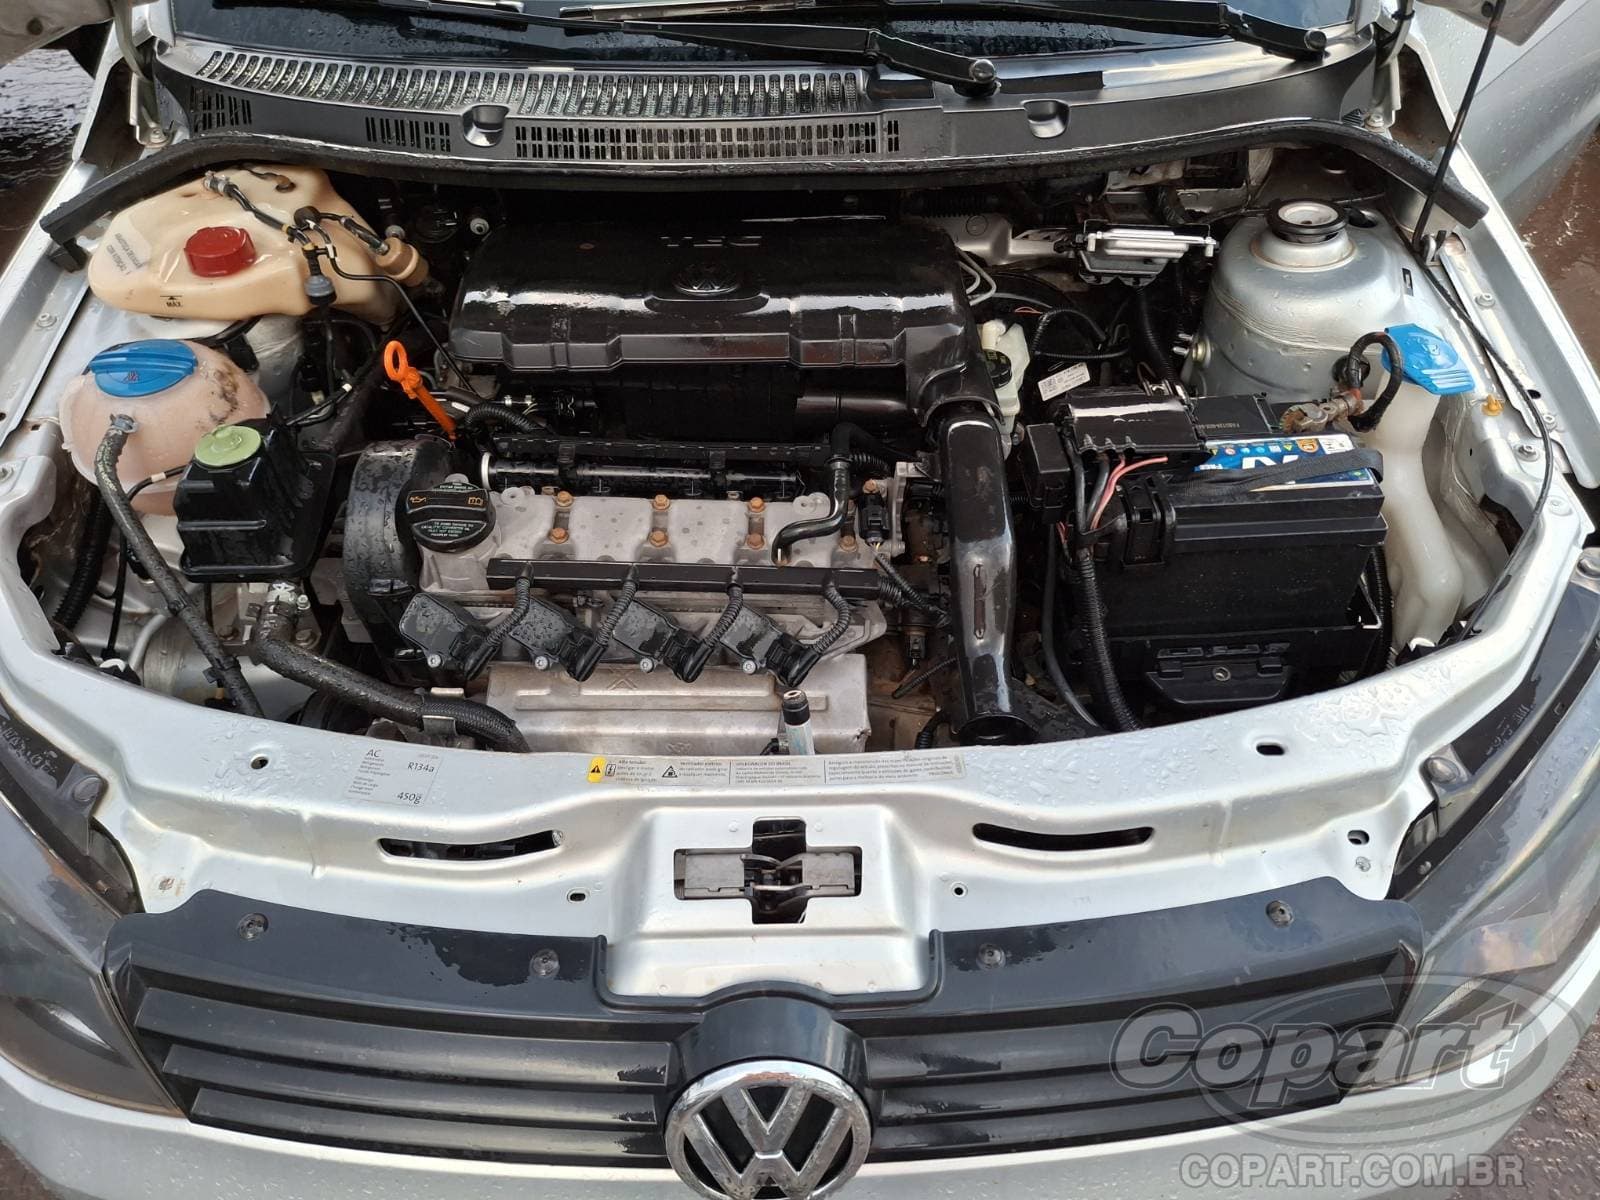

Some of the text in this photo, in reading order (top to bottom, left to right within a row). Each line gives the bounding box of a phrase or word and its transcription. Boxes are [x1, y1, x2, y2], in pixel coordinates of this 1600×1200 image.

[366, 748, 382, 758] AC
[407, 761, 435, 773] R134a
[397, 792, 422, 805] 450g
[680, 1082, 856, 1200] VW
